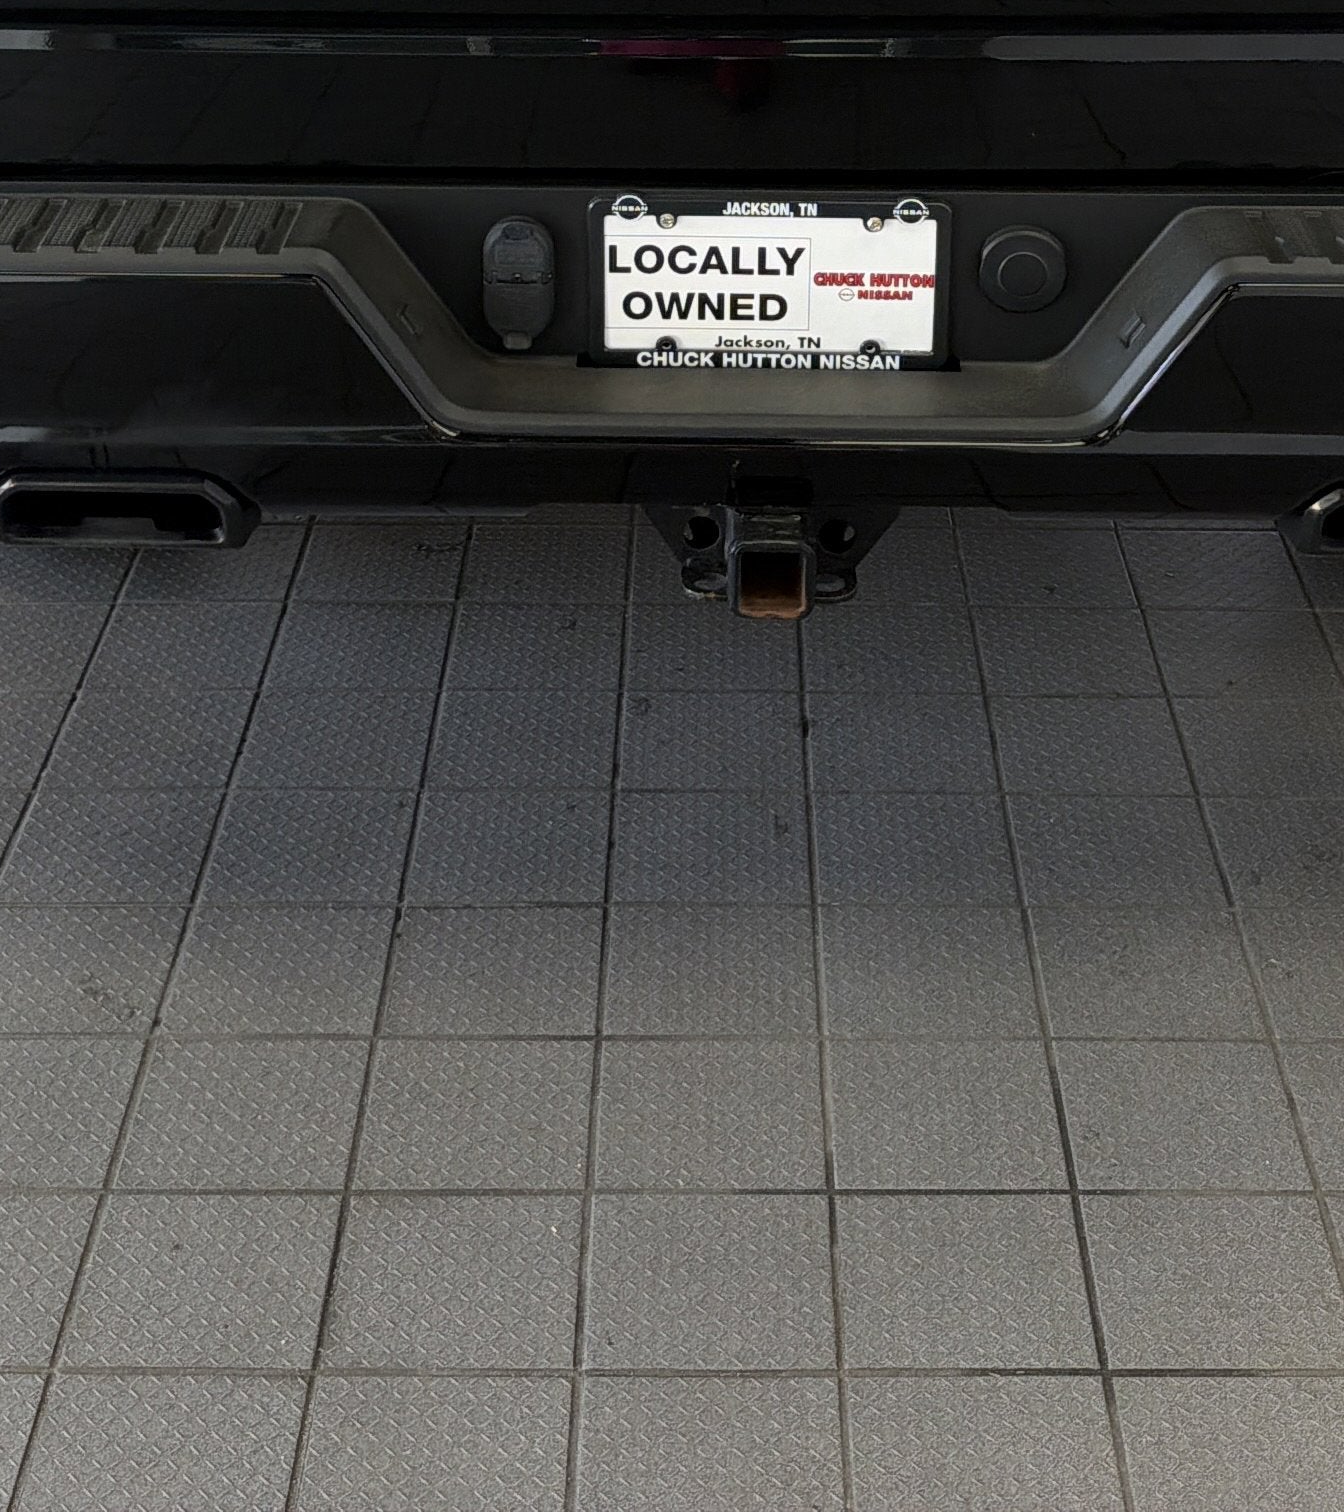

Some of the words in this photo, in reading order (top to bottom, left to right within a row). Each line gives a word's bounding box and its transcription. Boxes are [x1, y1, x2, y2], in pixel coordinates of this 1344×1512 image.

[611, 204, 648, 213] NISSAN
[722, 201, 794, 218] JACKSON,
[798, 203, 818, 217] TN
[893, 208, 929, 217] NISSAN
[608, 244, 806, 276] LOCALLY
[813, 272, 865, 287] CHUCK
[870, 273, 935, 288] HUTTON
[857, 289, 913, 301] NISSAN
[622, 291, 788, 321] OWNED
[714, 334, 791, 351] Jackson,
[797, 337, 821, 349] TN
[636, 351, 713, 369] CHUCK
[722, 352, 812, 369] HUTTON
[819, 353, 900, 370] NISSAN
